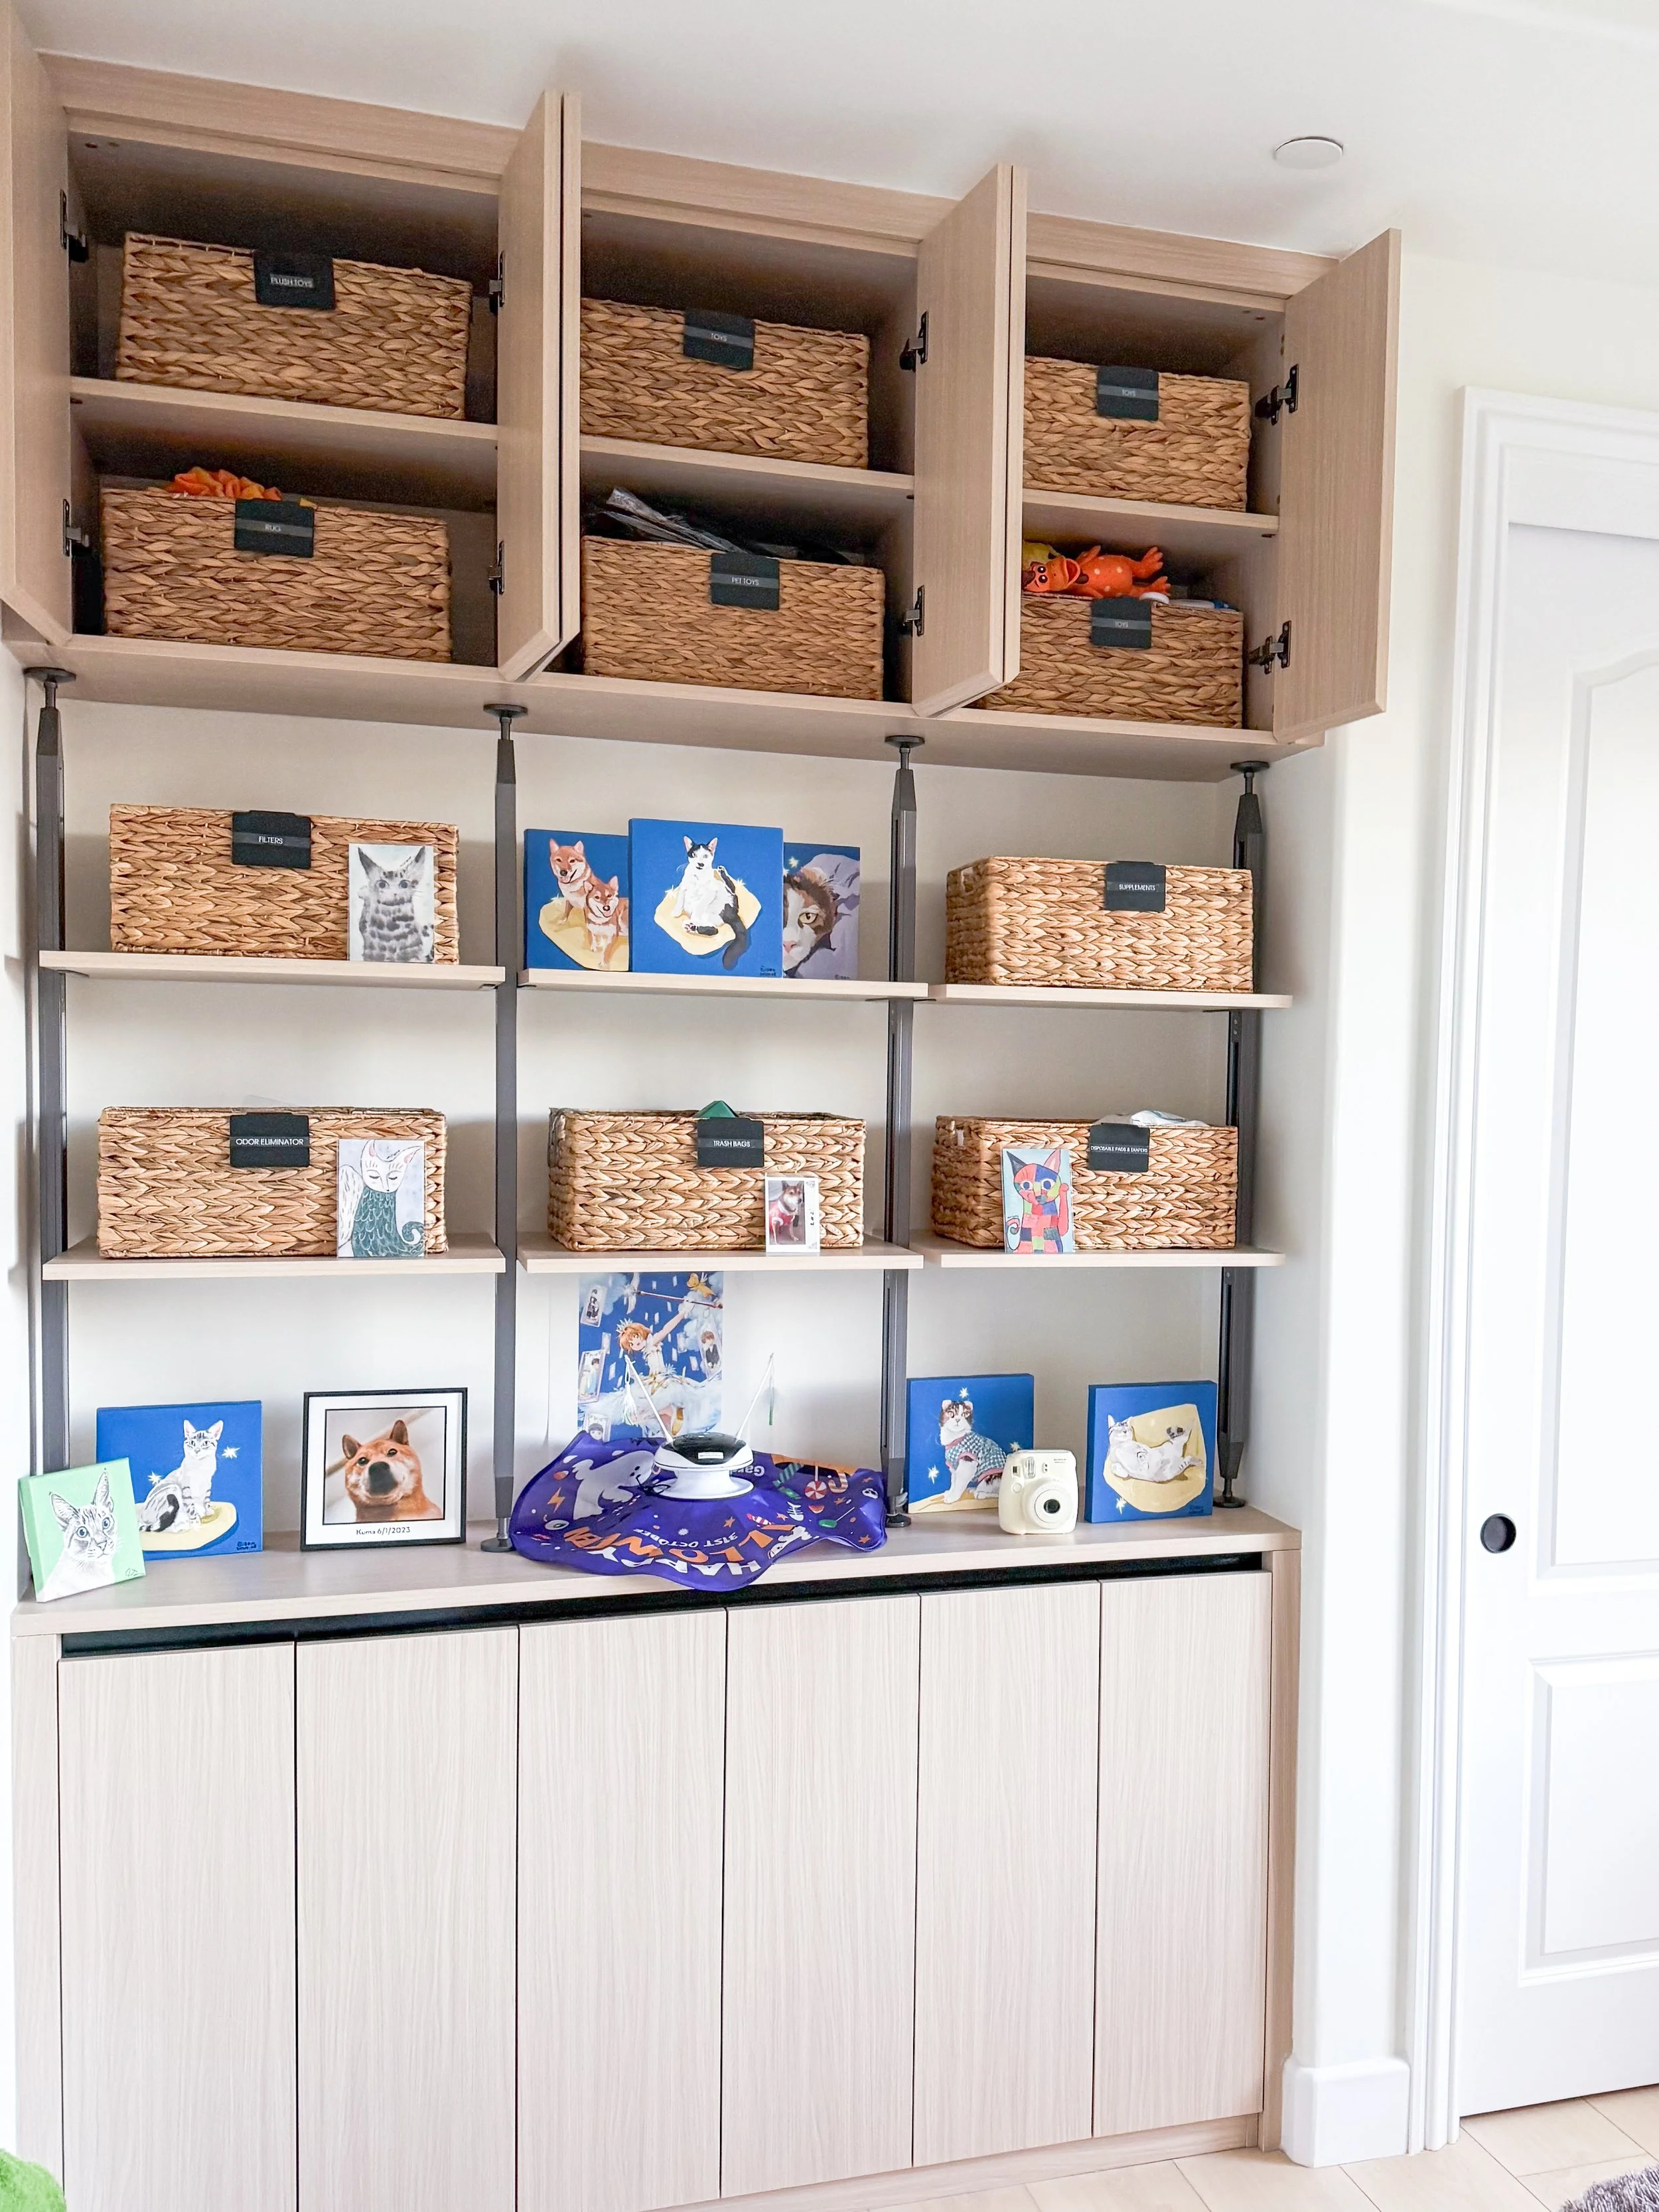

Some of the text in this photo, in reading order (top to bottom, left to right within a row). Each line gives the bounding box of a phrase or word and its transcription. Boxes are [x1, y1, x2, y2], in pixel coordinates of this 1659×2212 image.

[270, 277, 313, 288] PLUSH TOYS
[711, 332, 727, 342] TOYS
[1121, 389, 1136, 398] TOYS
[265, 524, 281, 532] RUG
[743, 577, 759, 586] TOYS
[258, 836, 283, 845] FILTERS
[377, 1526, 411, 1536] 6/1/2023
[632, 1528, 738, 1548] 31ST OCTOBER
[588, 1546, 762, 1576] HAPPY
